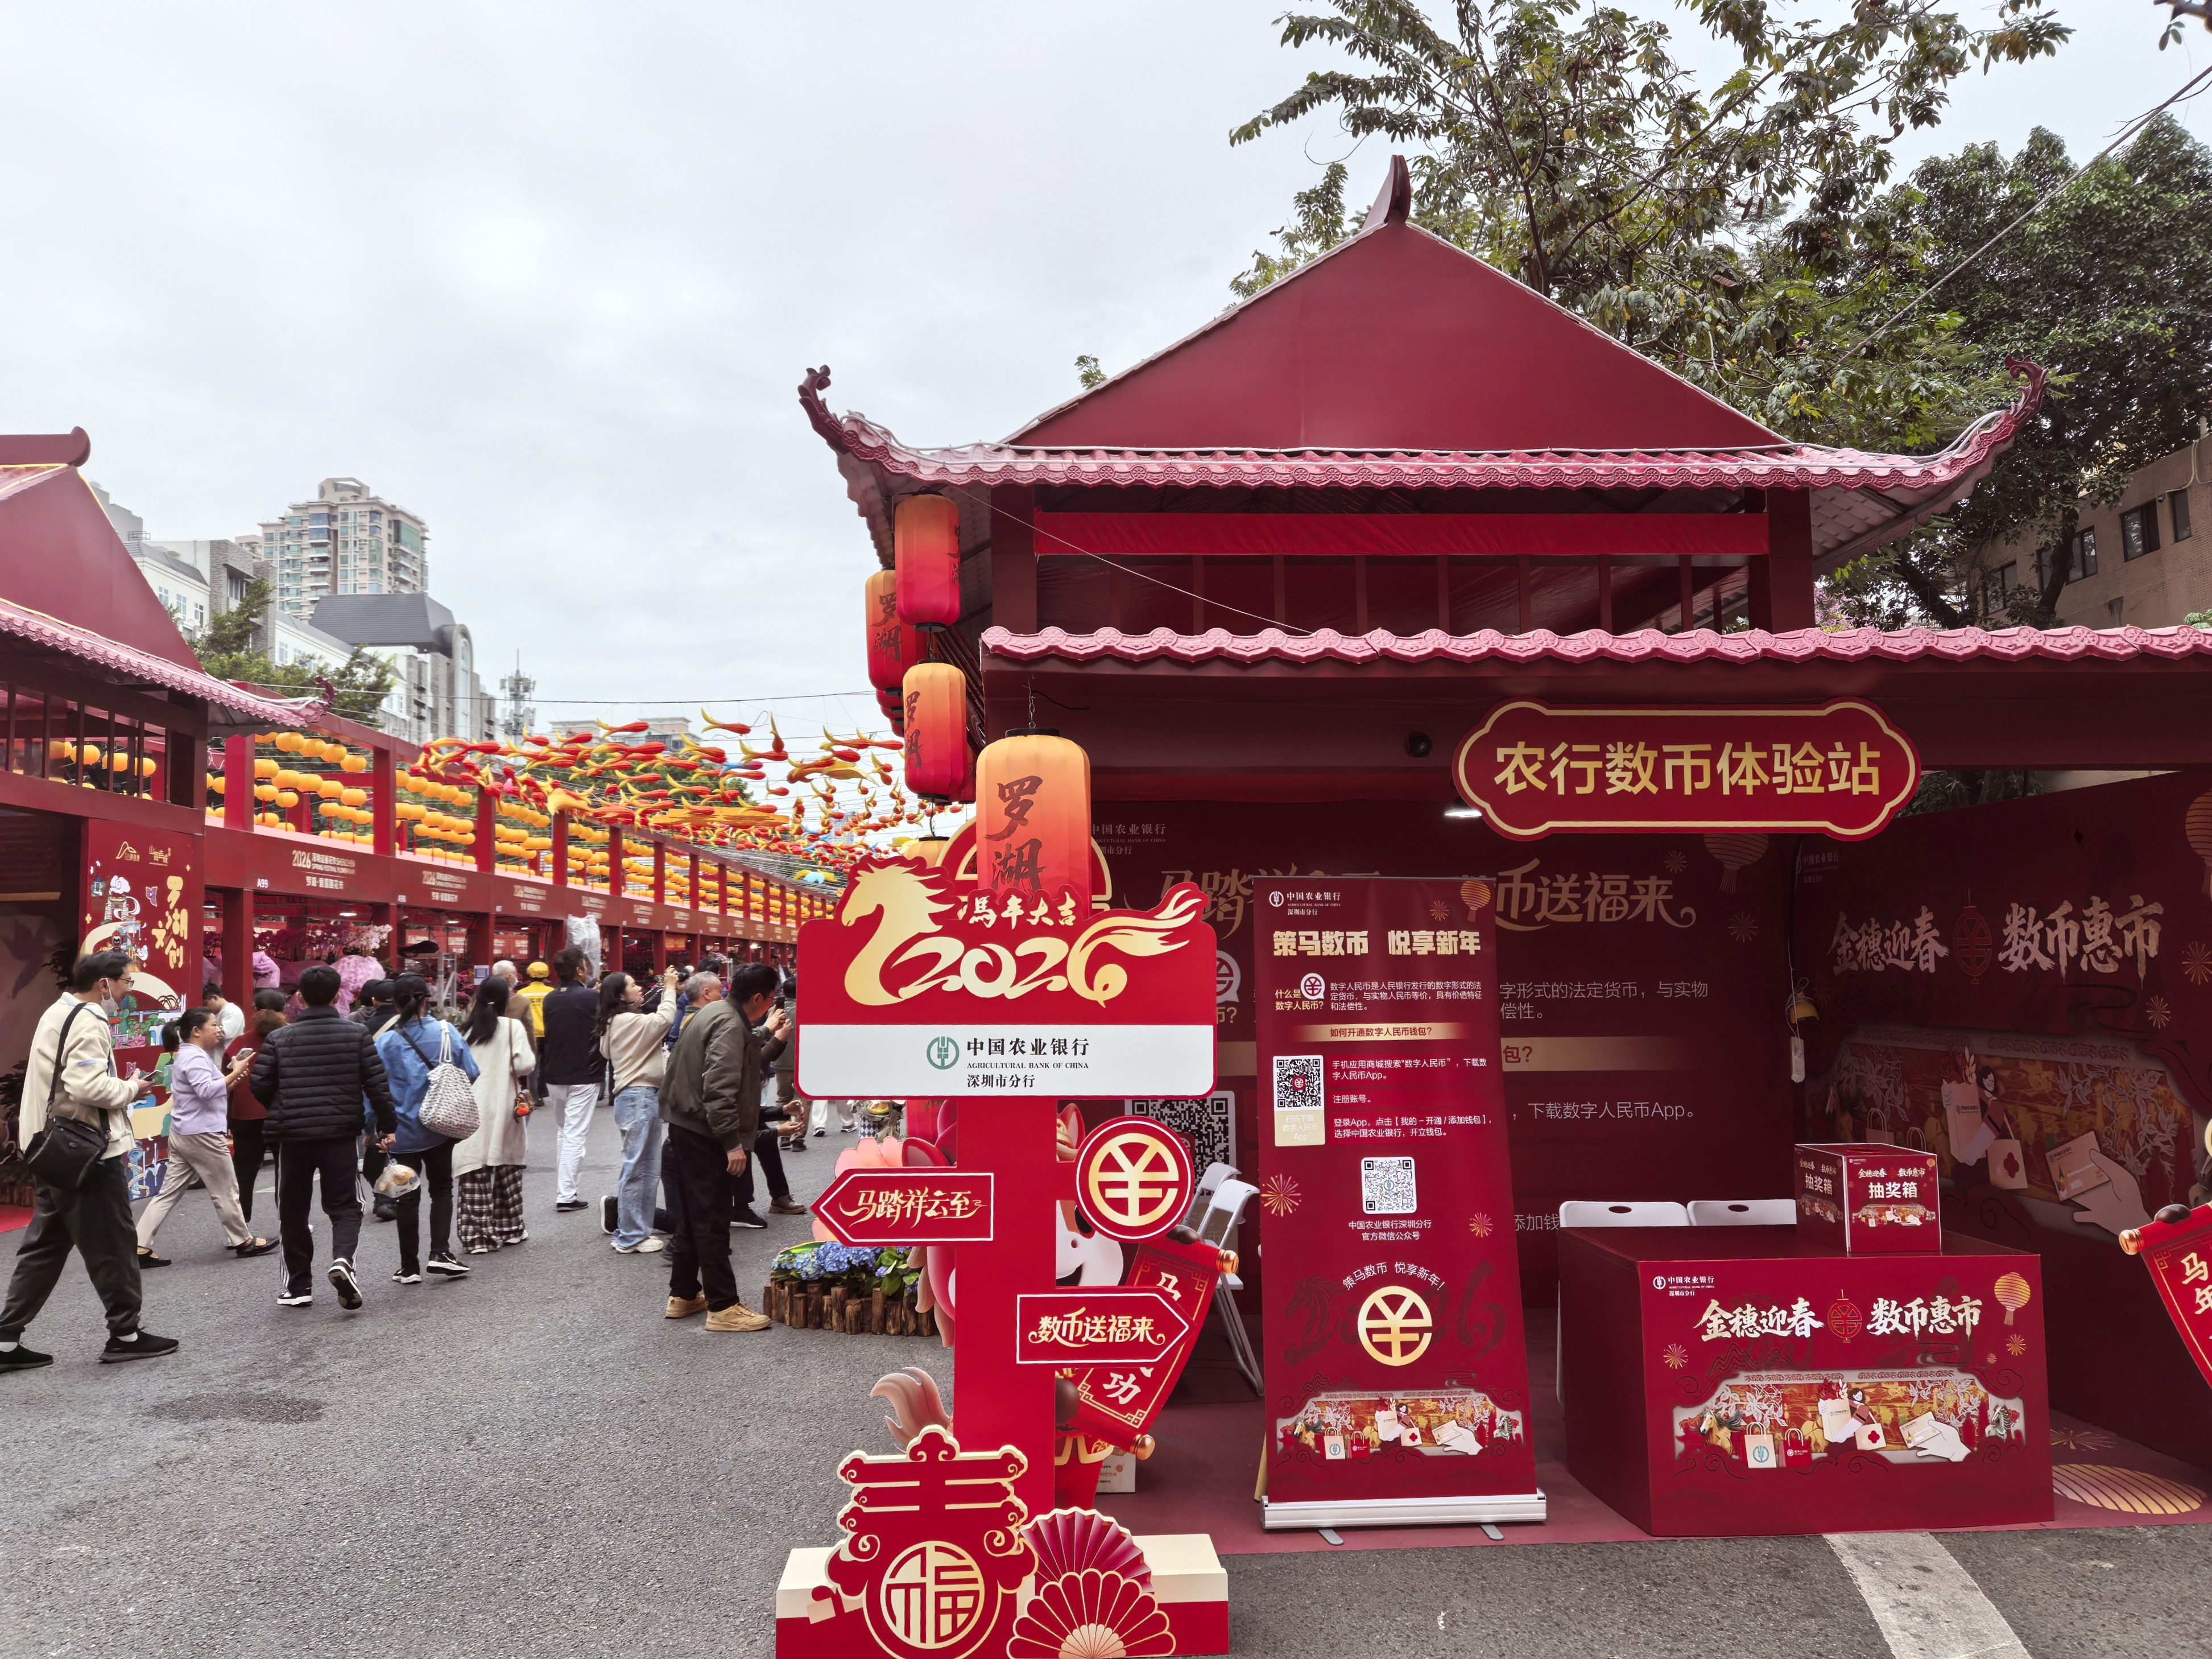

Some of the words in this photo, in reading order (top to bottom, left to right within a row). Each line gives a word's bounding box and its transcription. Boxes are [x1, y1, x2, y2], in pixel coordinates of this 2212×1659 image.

[1494, 741, 1880, 795] 农行数币体验站
[983, 775, 1048, 903] 罗湖
[292, 850, 311, 869] 2026
[257, 878, 268, 888] A99
[1287, 892, 1341, 901] 中国农业银行
[1462, 857, 1696, 931] 币送福来
[1274, 930, 1368, 956] 策马数币
[1388, 930, 1481, 955] 悦享新年
[1827, 905, 1950, 976] 金穗迎春
[1998, 894, 2164, 991] 数币惠市
[1275, 989, 1301, 998] 什么是
[1330, 981, 1481, 991] 数字人民币是人民银行发行的数字形式的法
[1330, 1002, 1368, 1011] 和法偿性。
[967, 1038, 1089, 1056] 中国农业银行
[967, 1074, 1035, 1088] 深圳市分行
[1333, 1095, 1371, 1104] 注册账号。
[1286, 1114, 1314, 1123] 扫码下载
[1283, 1123, 1317, 1132] 数字人民币
[1293, 1133, 1308, 1142] App
[1805, 1173, 1833, 1195] 抽奖箱
[1868, 1182, 1917, 1199] 抽奖箱
[839, 1186, 987, 1228] 马踏祥云至
[1349, 1219, 1432, 1229] 中国农业银行深圳分行
[1362, 1231, 1420, 1241] 官方微信公众号
[1342, 1262, 1387, 1290] 策马数币
[1028, 1307, 1165, 1347] 数币送福来
[1693, 1297, 1824, 1342] 金穗迎春
[1867, 1295, 1983, 1341] 数币惠市
[881, 1541, 985, 1649] 福
